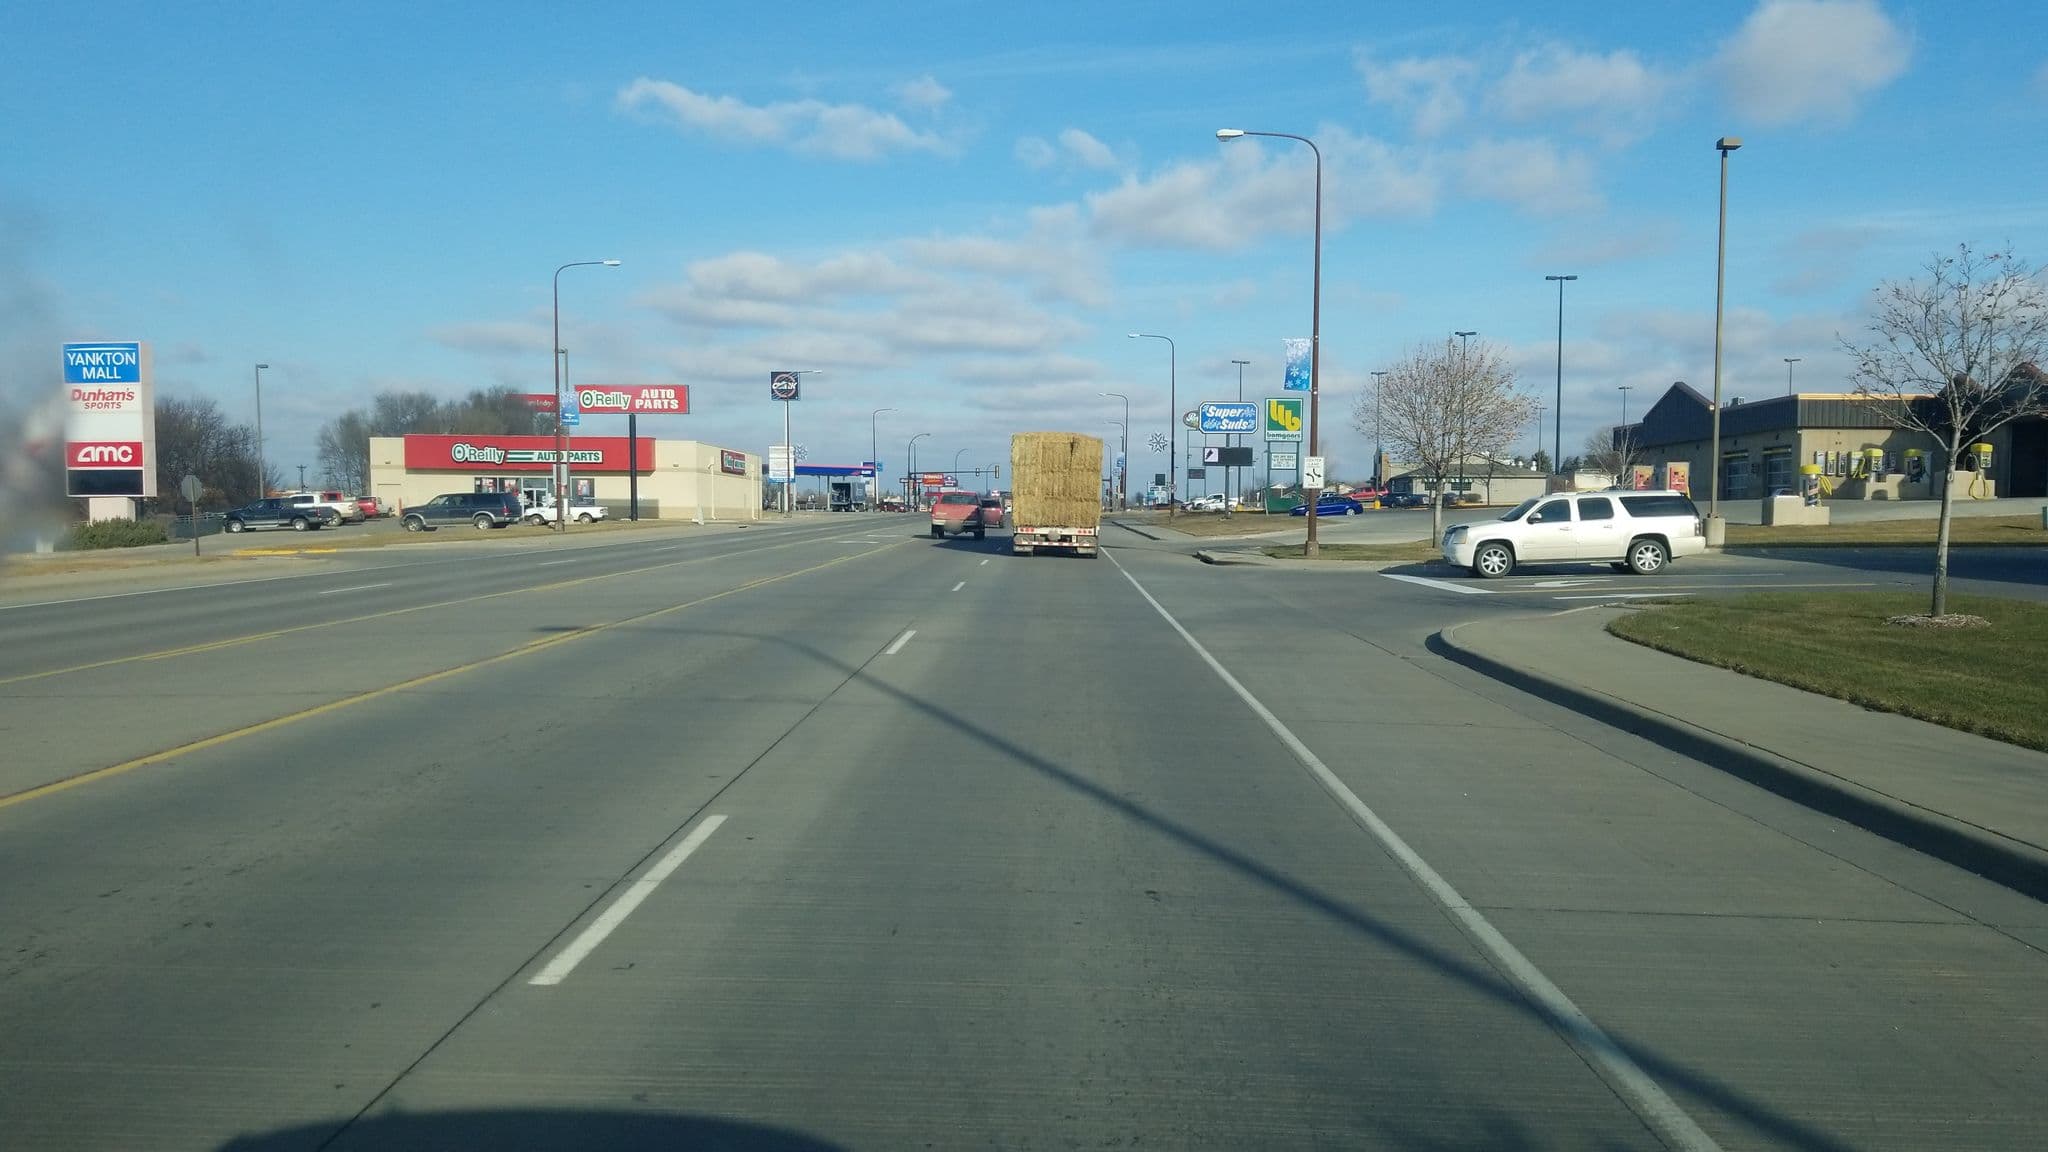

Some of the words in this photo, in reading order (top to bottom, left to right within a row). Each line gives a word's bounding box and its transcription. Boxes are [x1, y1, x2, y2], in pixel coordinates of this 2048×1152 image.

[67, 352, 136, 366] YANKTON
[82, 367, 121, 380] MALL
[71, 388, 135, 402] Dunham's
[580, 390, 631, 409] O'Reilly
[641, 388, 675, 399] AUTO
[84, 402, 122, 410] SPORTS
[635, 399, 679, 410] PARTS
[1206, 404, 1243, 421] Super
[1219, 418, 1249, 431] Suds
[452, 443, 505, 463] O'Reilly
[537, 451, 564, 461] AUTO
[567, 451, 601, 461] PARTS
